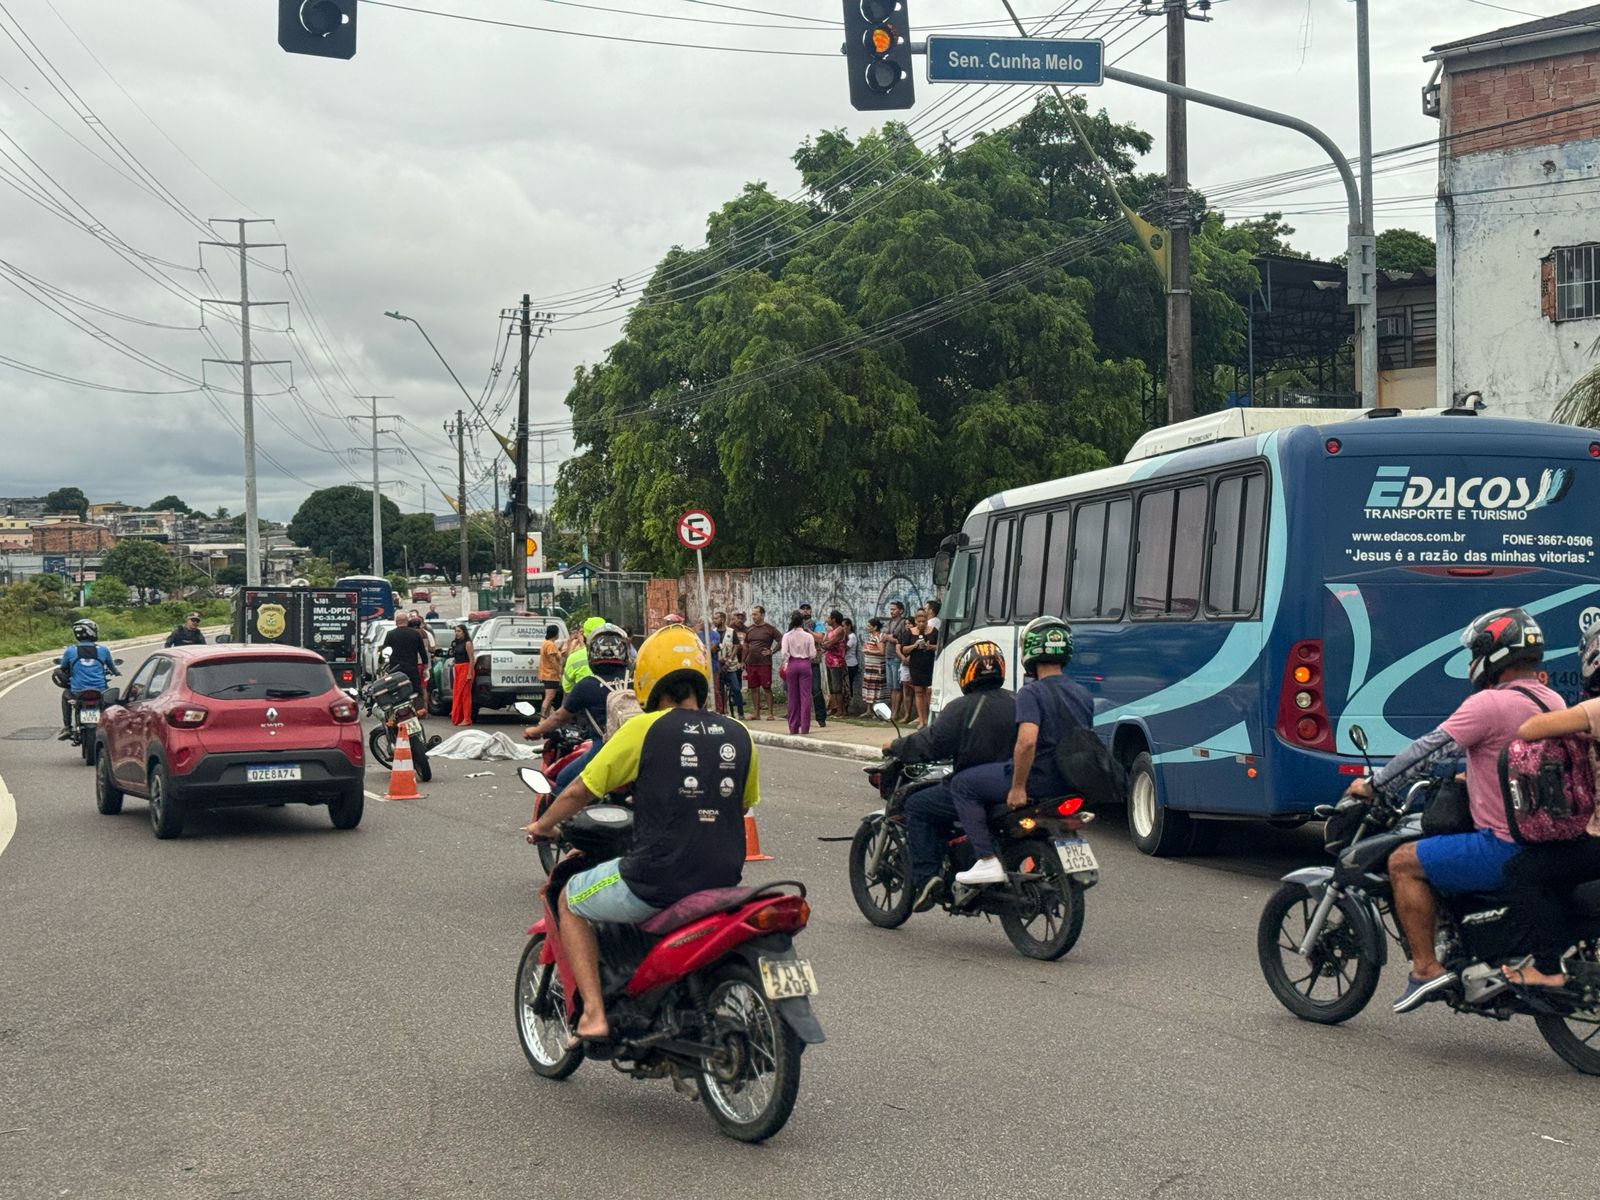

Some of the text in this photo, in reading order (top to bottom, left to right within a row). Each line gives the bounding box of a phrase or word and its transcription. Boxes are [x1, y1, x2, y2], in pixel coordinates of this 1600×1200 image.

[948, 51, 1083, 71] Sen. Cunha Melo
[1365, 466, 1531, 510] EDACOS
[1364, 509, 1527, 521] TRANSPORTE E TURISMO
[1351, 531, 1466, 543] www.edacos.com.br
[1345, 549, 1594, 564] "Jesus é a razão das minhas vitorias."
[501, 674, 530, 684] POLÍCIA
[1065, 856, 1094, 870] 1C28
